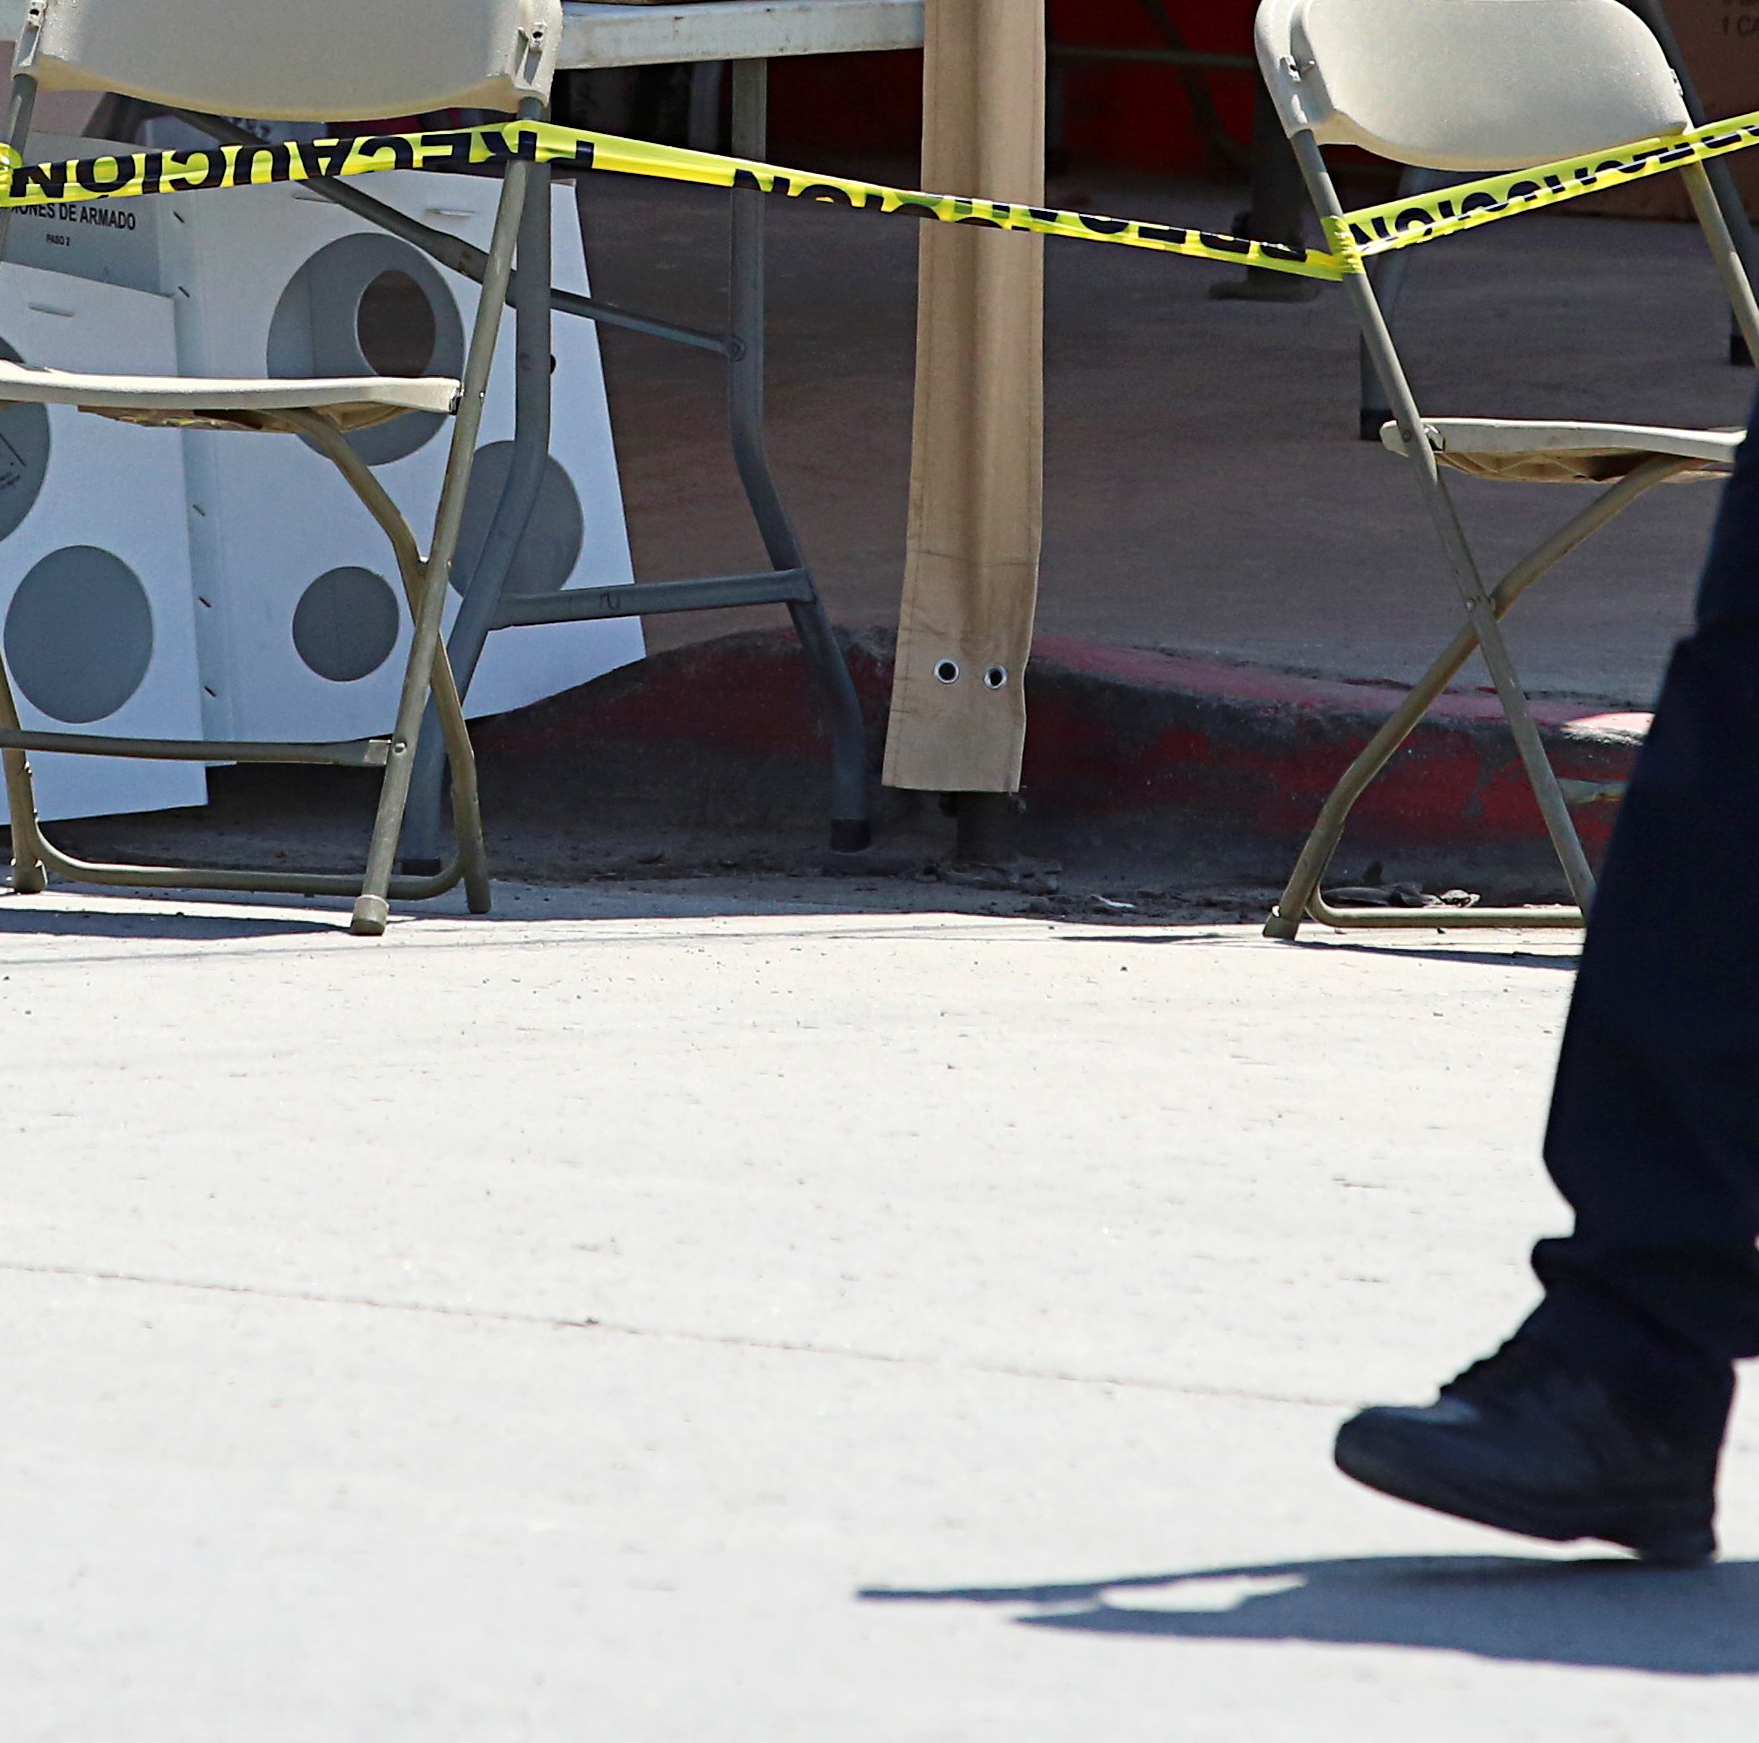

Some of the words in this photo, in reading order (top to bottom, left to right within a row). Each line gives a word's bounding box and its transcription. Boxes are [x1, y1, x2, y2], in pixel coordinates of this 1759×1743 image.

[59, 204, 77, 221] DE
[80, 206, 136, 231] ARMADO
[45, 233, 64, 246] PASO
